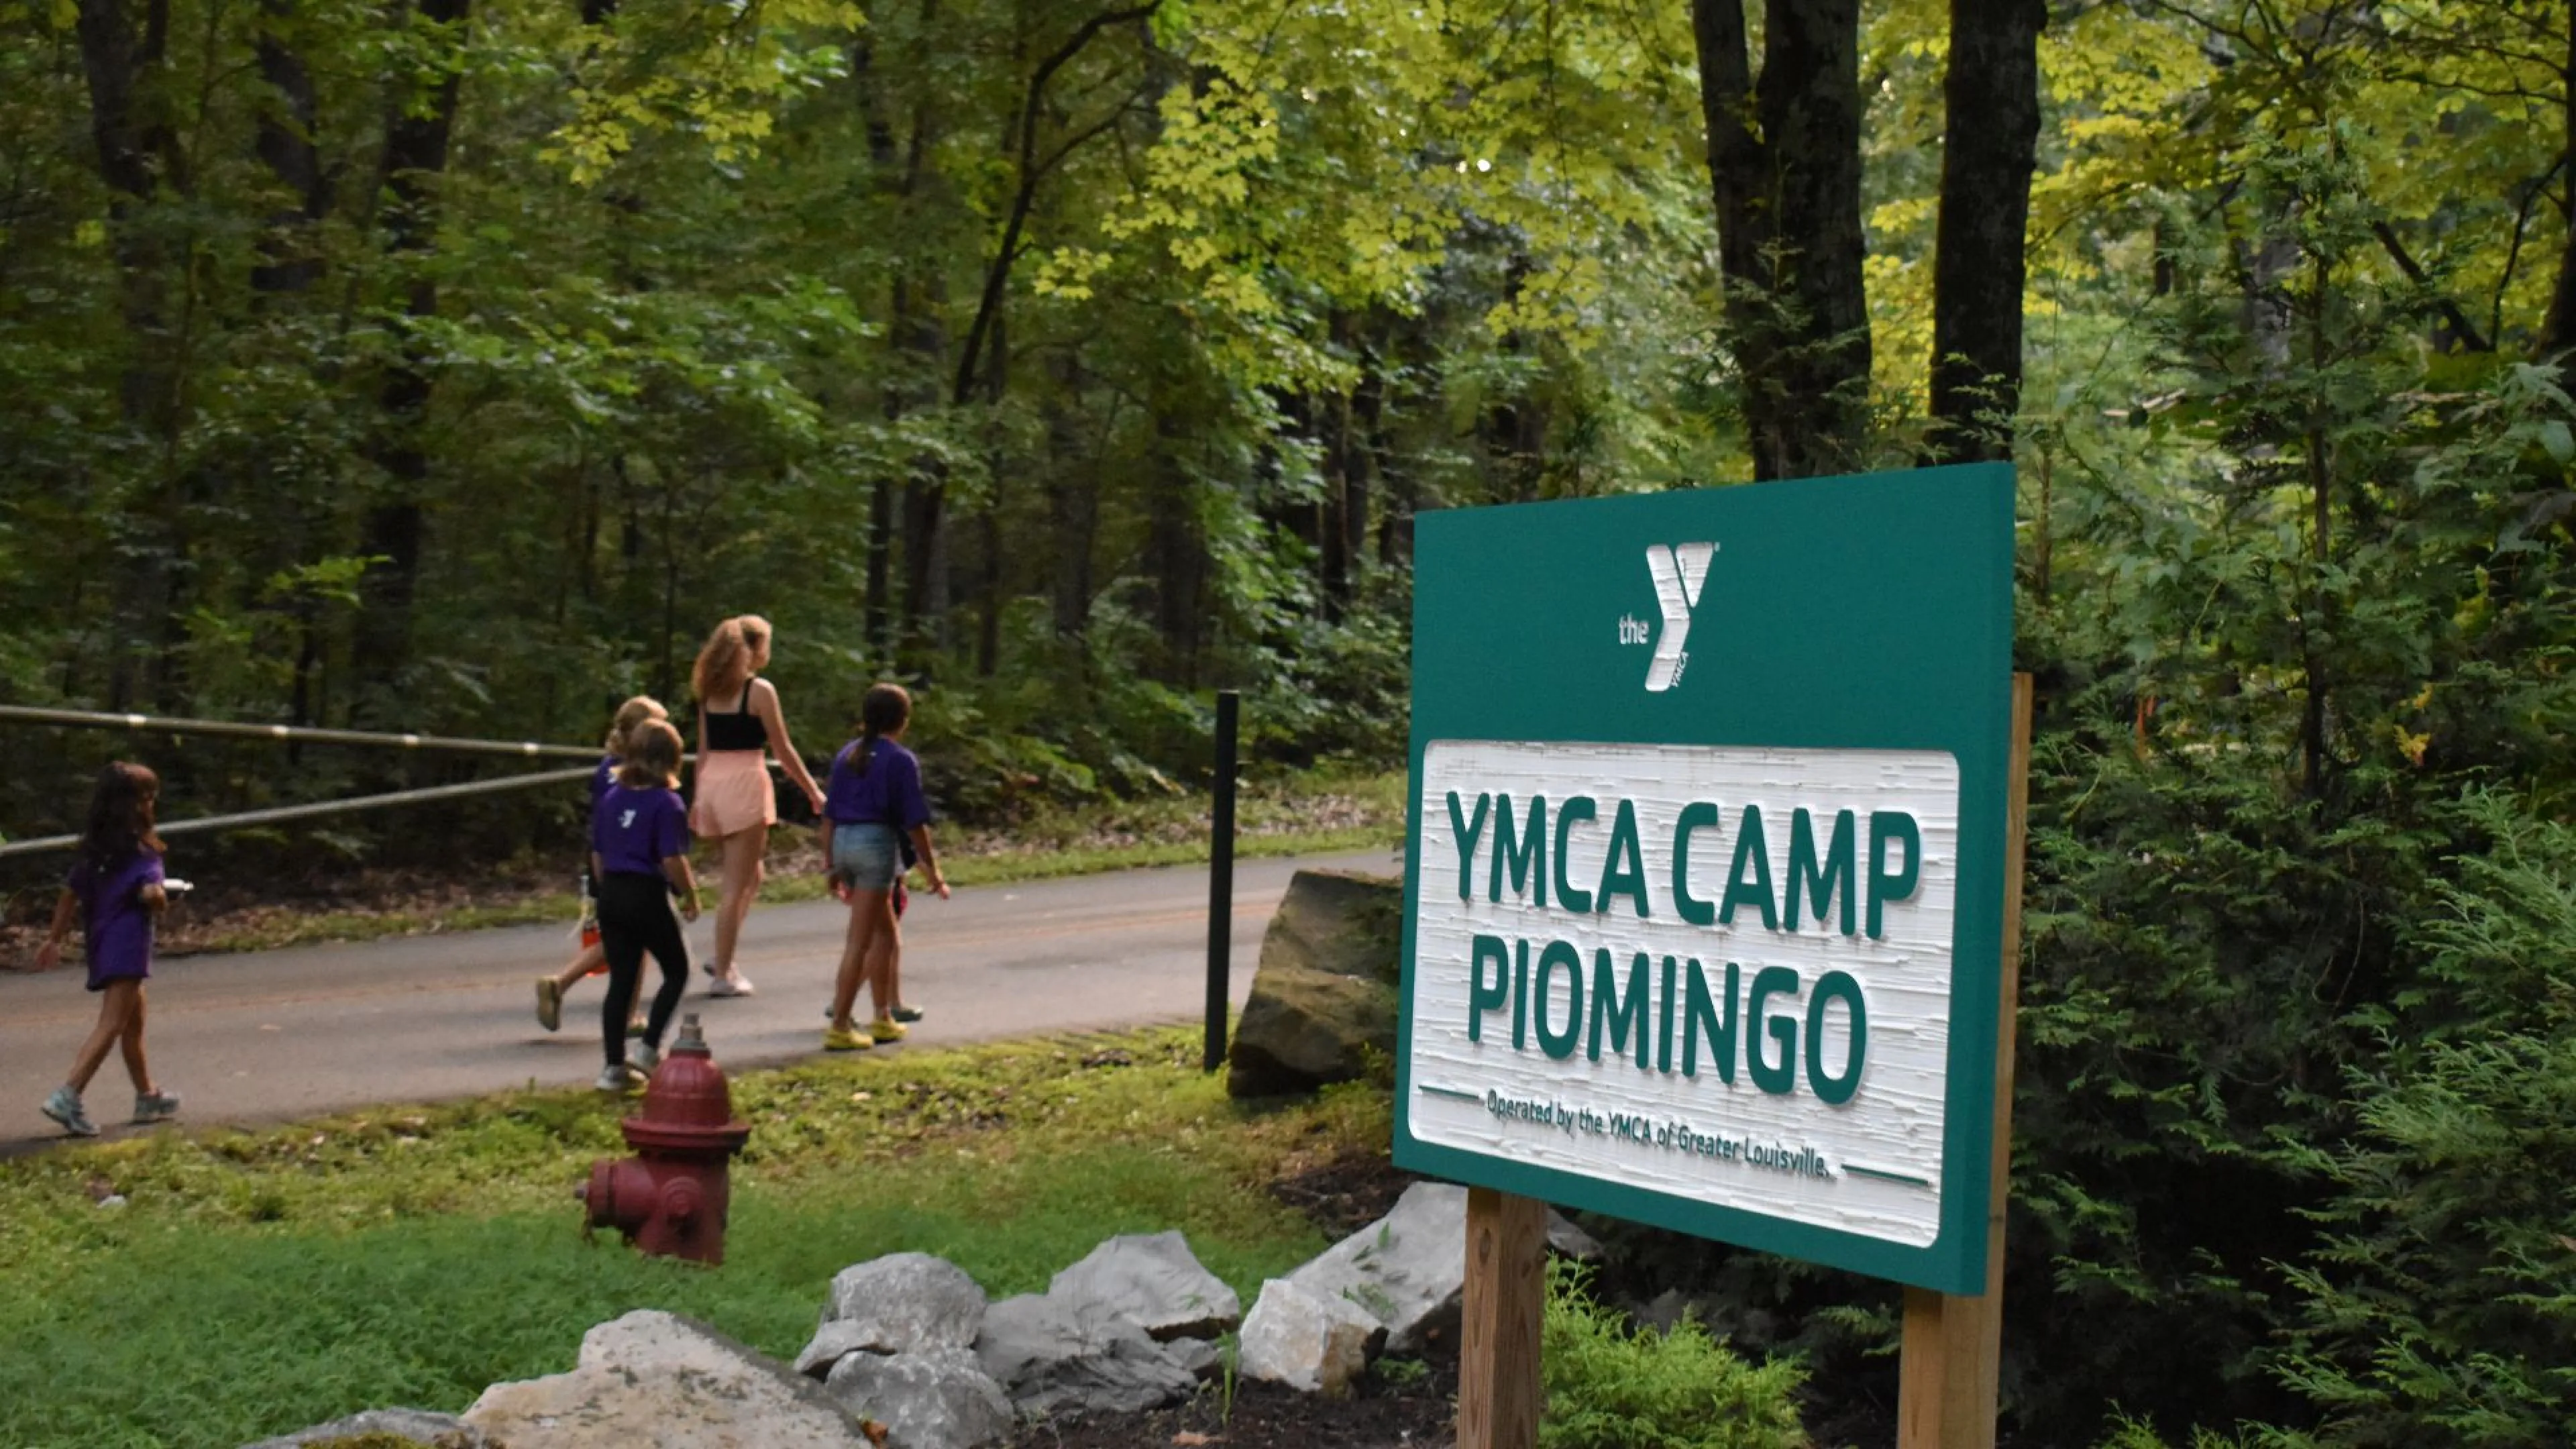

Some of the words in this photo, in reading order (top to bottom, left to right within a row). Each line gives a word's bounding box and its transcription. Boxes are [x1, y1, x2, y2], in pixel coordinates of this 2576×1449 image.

[1619, 612, 1649, 645] the
[1446, 792, 1650, 918] YMCA
[1672, 802, 1921, 939] CAMP
[1468, 934, 1867, 1106] PIOMINGO
[1487, 1088, 1554, 1124] Operated
[1557, 1102, 1575, 1134] by
[1580, 1108, 1603, 1134] the
[1609, 1111, 1652, 1143] YMCA
[1657, 1121, 1674, 1148] of
[1678, 1125, 1740, 1161] Greater
